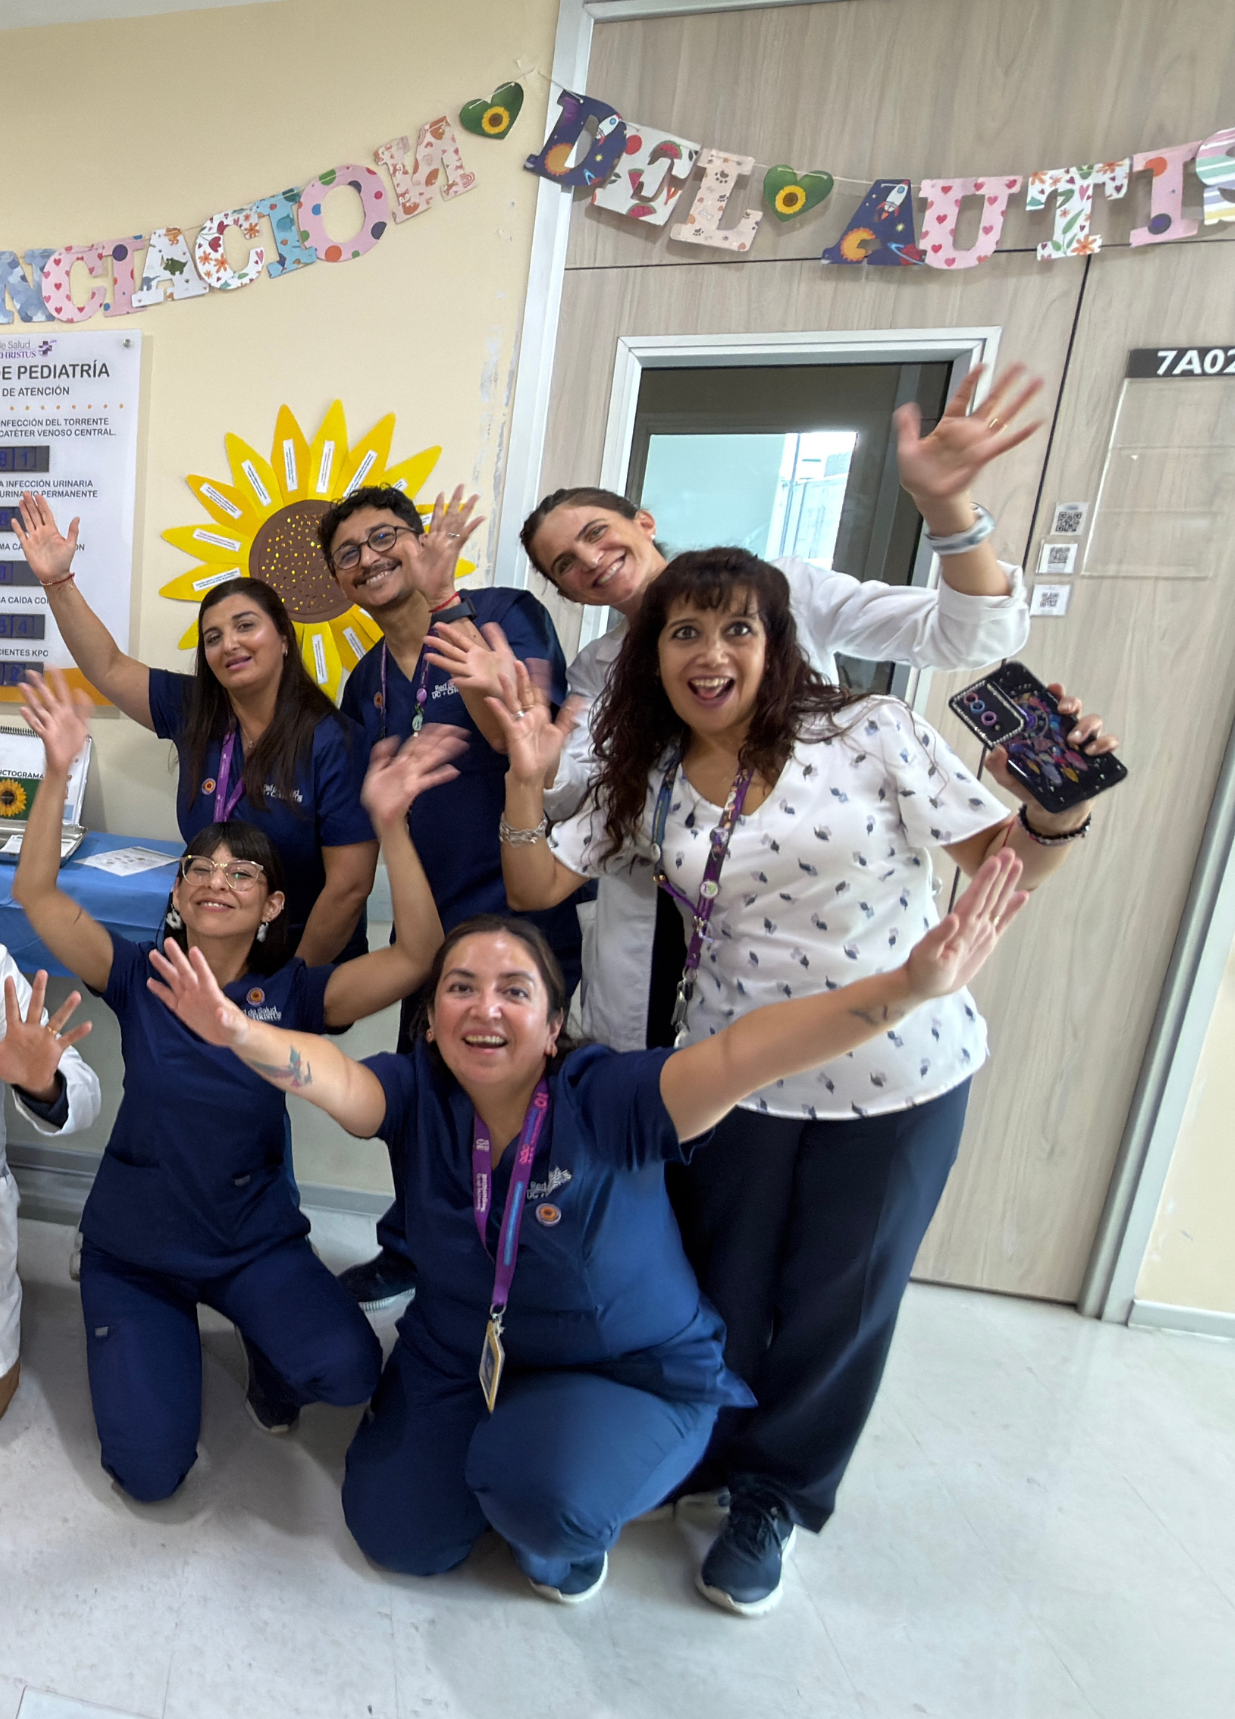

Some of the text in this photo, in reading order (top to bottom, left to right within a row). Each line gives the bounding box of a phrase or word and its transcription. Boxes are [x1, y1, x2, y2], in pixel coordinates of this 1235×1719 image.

[523, 88, 763, 252] DEL
[7, 340, 30, 350] Salud
[17, 360, 110, 380] PEDIATRÍA
[1, 387, 16, 398] DE
[18, 385, 70, 397] ATENCIÓN
[45, 419, 62, 427] DEL
[64, 418, 109, 427] TORRENTE
[37, 430, 72, 438] VENOSO
[74, 429, 116, 437] CENTRAL.
[6, 479, 51, 488] INFECCIÓN
[53, 480, 93, 488] URINARIA
[41, 490, 98, 499] PERMANENTE
[8, 594, 31, 605] CAÍDA
